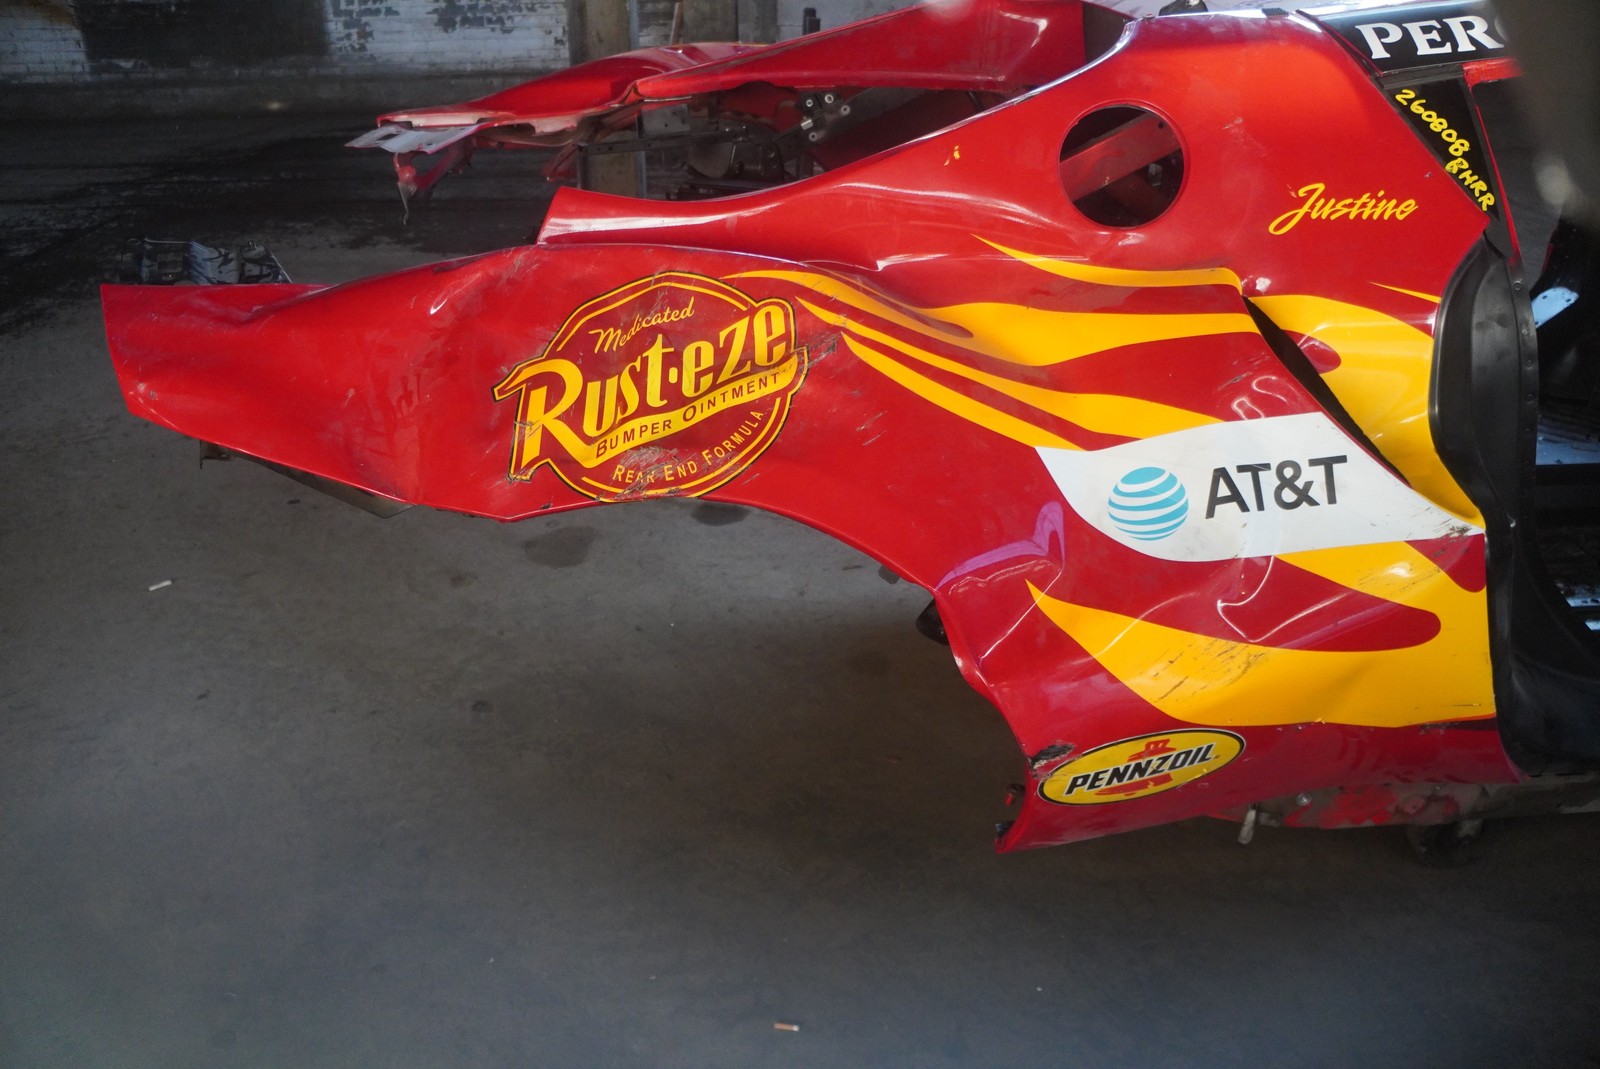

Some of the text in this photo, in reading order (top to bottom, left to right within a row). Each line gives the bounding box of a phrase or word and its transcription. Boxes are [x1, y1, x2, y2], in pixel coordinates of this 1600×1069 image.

[1355, 15, 1508, 59] PER
[1395, 89, 1470, 156] 260808
[1268, 182, 1418, 235] Justine
[588, 296, 695, 354] Medicated
[596, 372, 780, 459] BUMPER OINTMENT
[664, 460, 698, 482] END
[701, 409, 764, 466] FORMULA
[1205, 454, 1348, 520] AT&T
[1063, 742, 1216, 796] PENNZOIL
